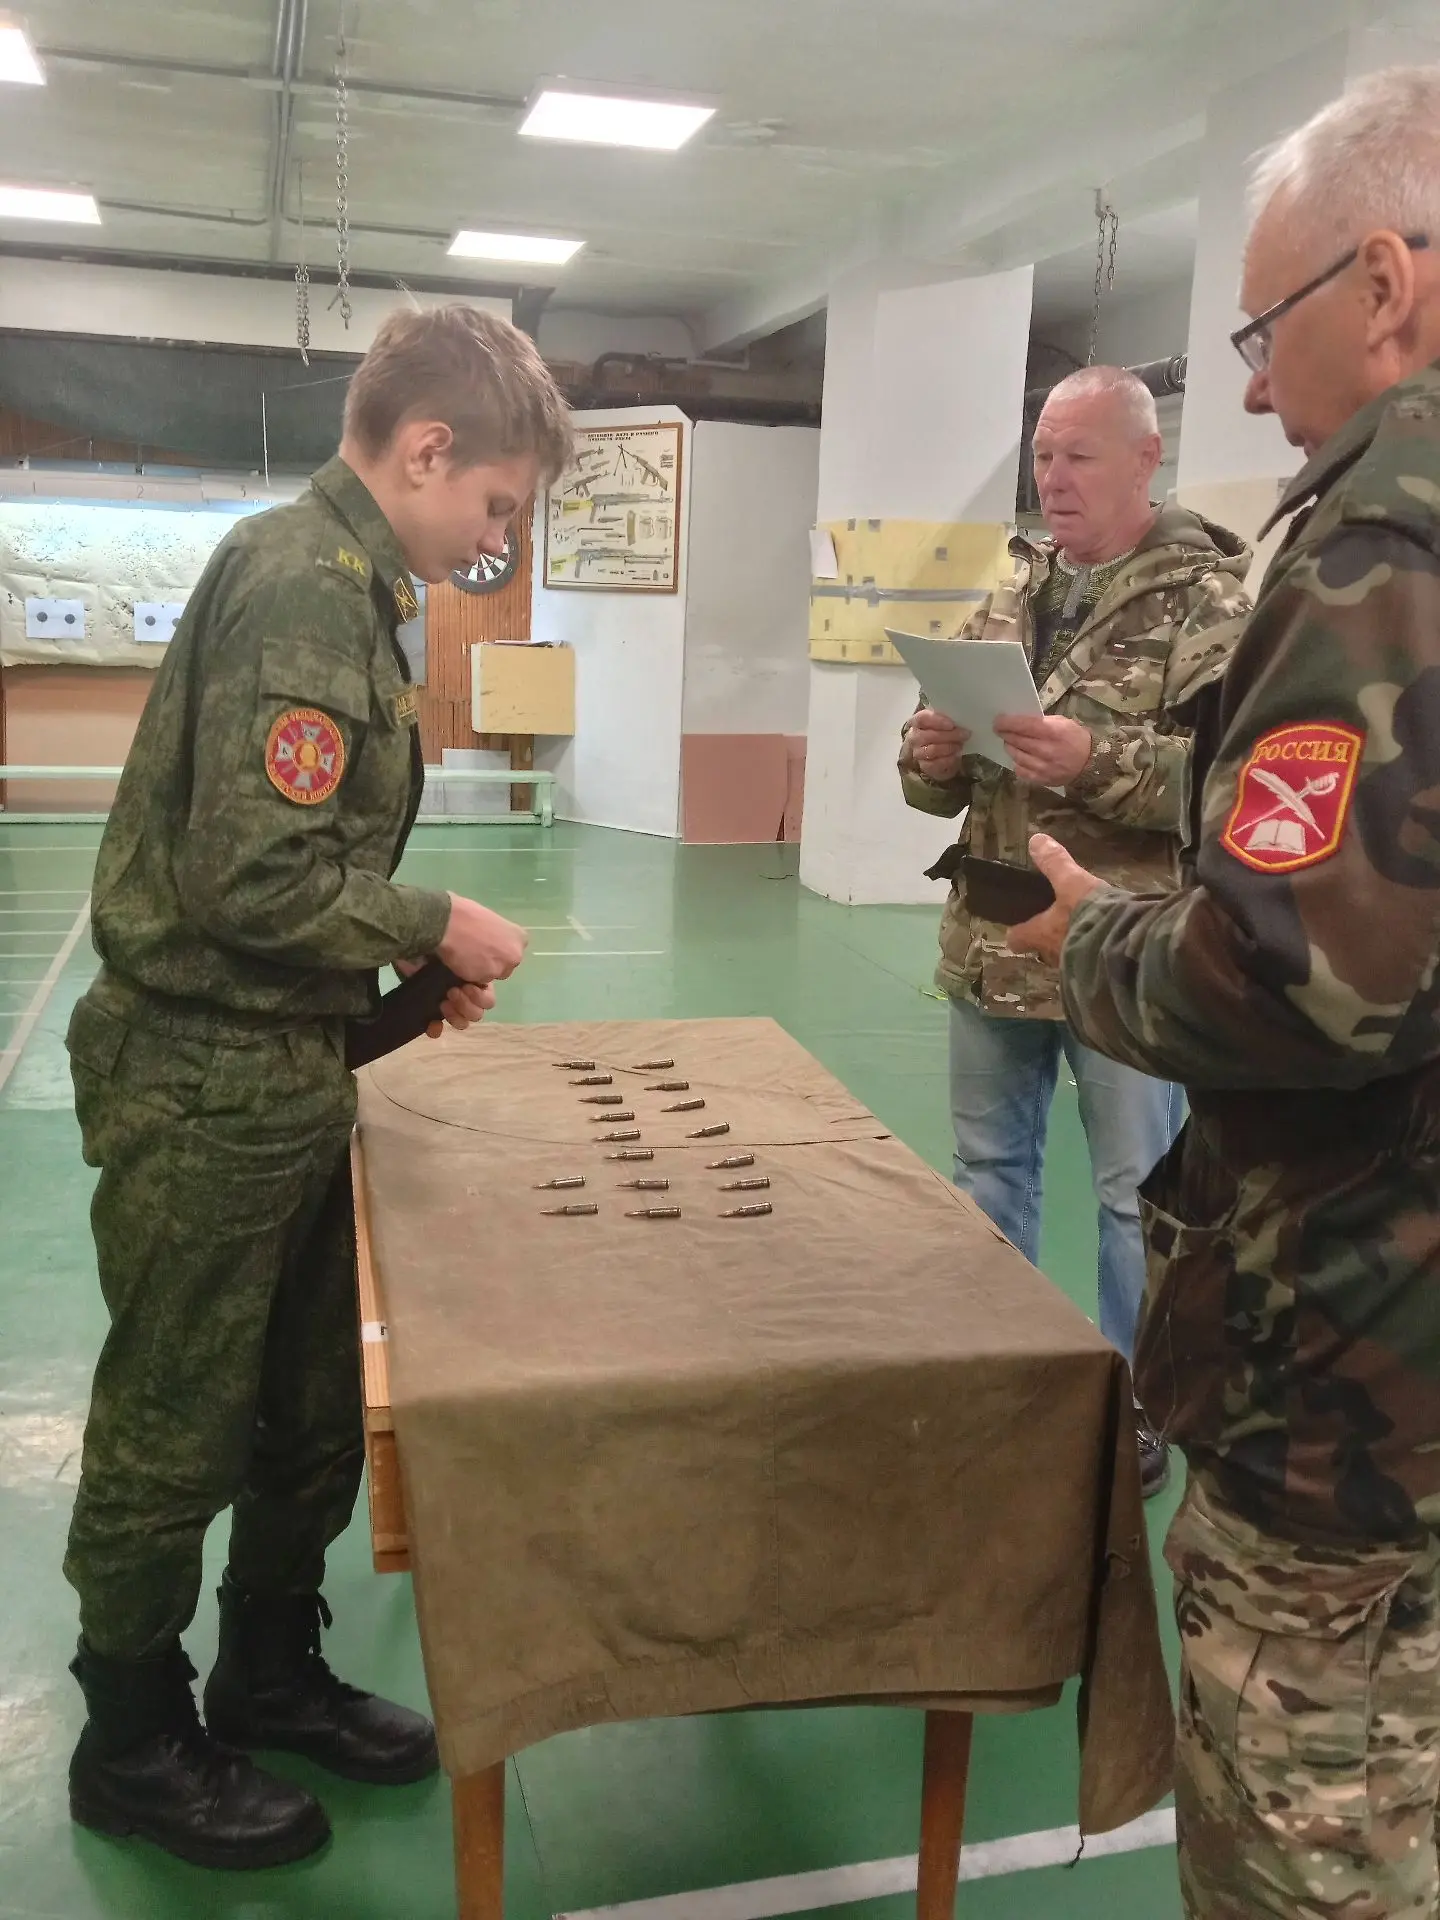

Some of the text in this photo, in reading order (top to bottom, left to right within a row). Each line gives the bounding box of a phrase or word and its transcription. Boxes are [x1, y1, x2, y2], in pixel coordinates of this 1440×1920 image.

[136, 484, 144, 498] 2
[336, 546, 367, 576] КК
[1252, 740, 1351, 763] РОССИЯ
